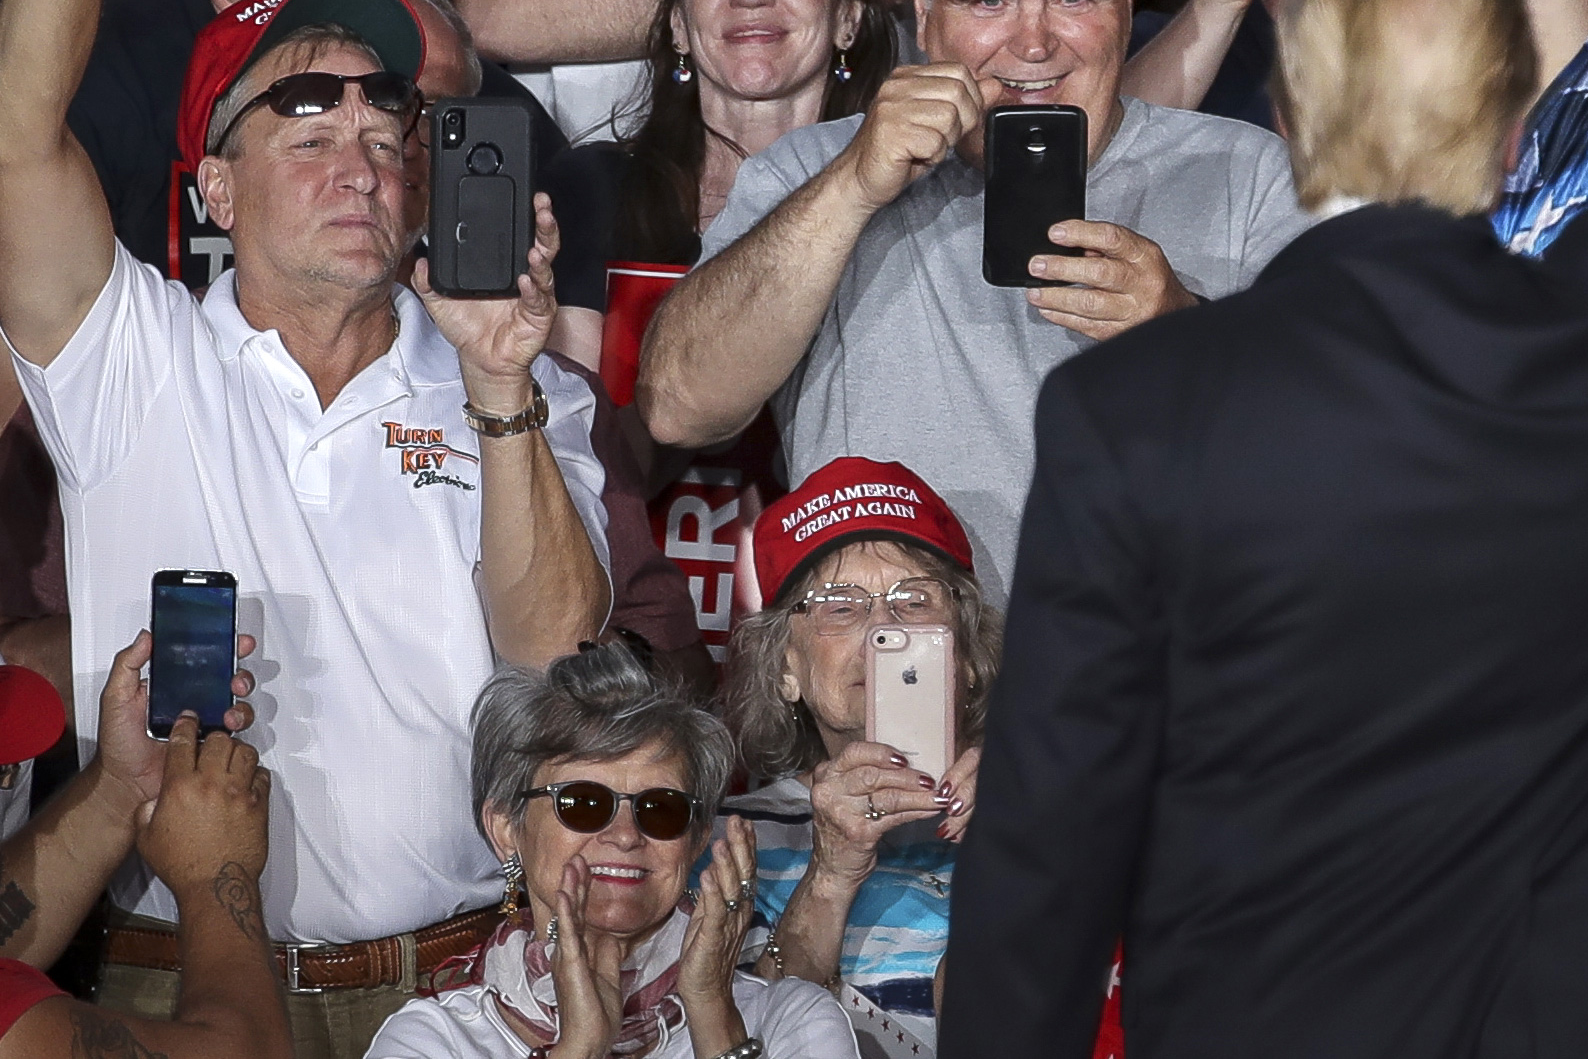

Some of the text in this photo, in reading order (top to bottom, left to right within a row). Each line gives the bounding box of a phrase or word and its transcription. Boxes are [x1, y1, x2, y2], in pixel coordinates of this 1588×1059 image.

[381, 421, 443, 449] TURN
[401, 448, 448, 475] KEY
[781, 483, 923, 533] MAKE AMERICA
[794, 501, 916, 542] GREAT AGAIN
